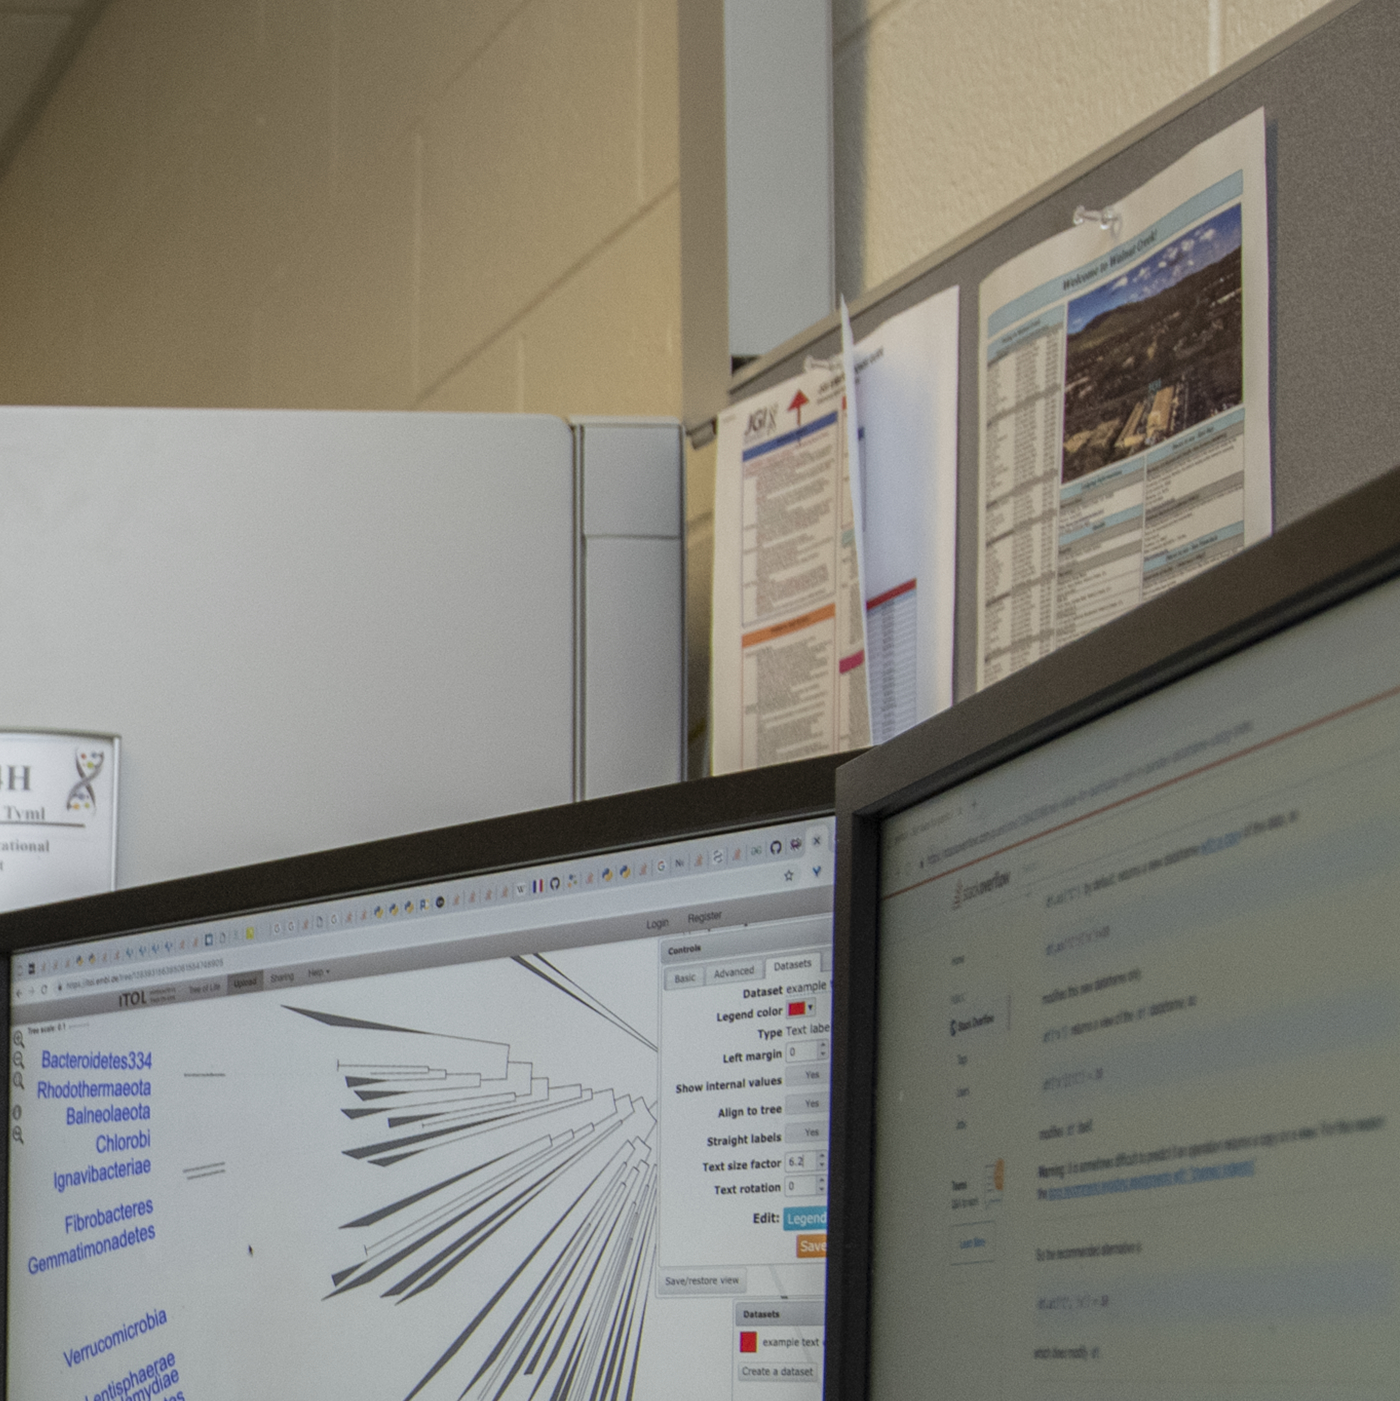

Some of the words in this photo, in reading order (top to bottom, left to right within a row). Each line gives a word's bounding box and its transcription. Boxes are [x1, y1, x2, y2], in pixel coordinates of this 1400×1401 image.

[646, 917, 669, 930] Login
[688, 910, 722, 924] Register
[668, 943, 701, 955] Controls
[674, 973, 696, 984] Basic
[714, 965, 755, 979] Advanced
[774, 959, 812, 971] Datasets
[743, 986, 783, 998] Dataset
[786, 980, 827, 995] example
[716, 1009, 754, 1023] Legend
[757, 1006, 783, 1017] color
[757, 1028, 783, 1041] Type
[786, 1025, 807, 1036] Text
[41, 1050, 152, 1070] Bacteroidetes334
[723, 1052, 742, 1064] Left
[746, 1049, 783, 1062] margin
[37, 1079, 152, 1099] Rhodothermaeota
[675, 1083, 703, 1094] Show
[706, 1077, 746, 1091] internal
[749, 1076, 783, 1087] values
[805, 1069, 820, 1080] Yes
[66, 1103, 151, 1125] Balneolaeota
[718, 1106, 745, 1119] Align
[747, 1105, 758, 1116] to
[760, 1104, 783, 1115] tree
[805, 1099, 820, 1108] Yes
[96, 1128, 151, 1153] Chlorobi
[706, 1134, 748, 1147] Straight
[751, 1132, 782, 1143] labels
[805, 1127, 819, 1137] Yes
[53, 1157, 151, 1193] Ignavibacteriae
[703, 1162, 725, 1172] Text
[727, 1160, 748, 1171] size
[751, 1158, 782, 1169] factor
[714, 1185, 737, 1195] Text
[740, 1182, 781, 1193] rotation
[65, 1199, 154, 1234] Fibrobacteres
[752, 1213, 780, 1224] Edit:
[27, 1223, 156, 1275] Gemmatimonadetes
[665, 1275, 718, 1287] Save/restore
[720, 1276, 739, 1285] view
[743, 1309, 780, 1319] Datasets
[63, 1308, 168, 1368] Verrucomicrobia
[762, 1337, 800, 1349] example
[802, 1337, 819, 1346] text
[741, 1366, 771, 1377] Create
[781, 1366, 813, 1377] dataset
